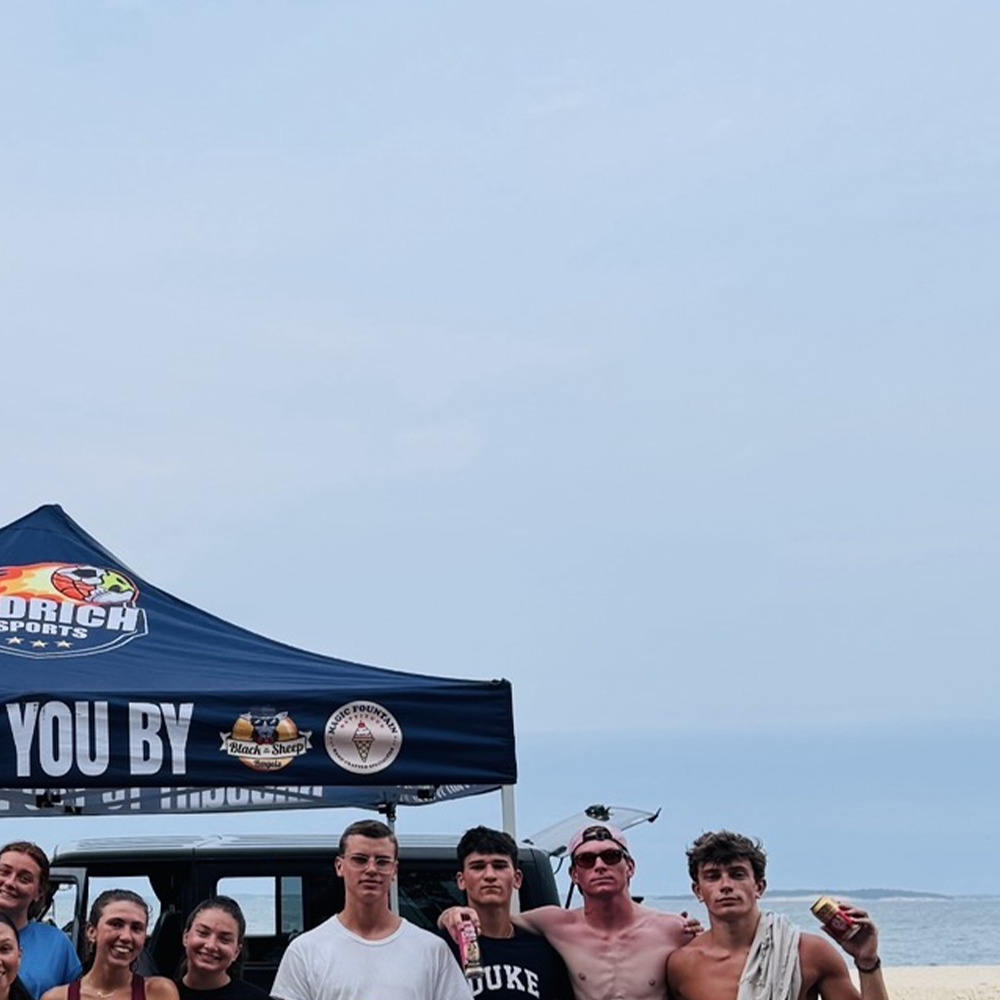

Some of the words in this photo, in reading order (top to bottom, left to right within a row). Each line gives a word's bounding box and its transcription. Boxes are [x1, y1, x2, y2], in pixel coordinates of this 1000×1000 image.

[328, 707, 351, 735] MAGIC
[352, 705, 398, 734] FOUNTAIN
[5, 700, 110, 777] YOU
[128, 702, 194, 776] BY
[229, 741, 260, 755] Black
[271, 741, 304, 755] Sheep
